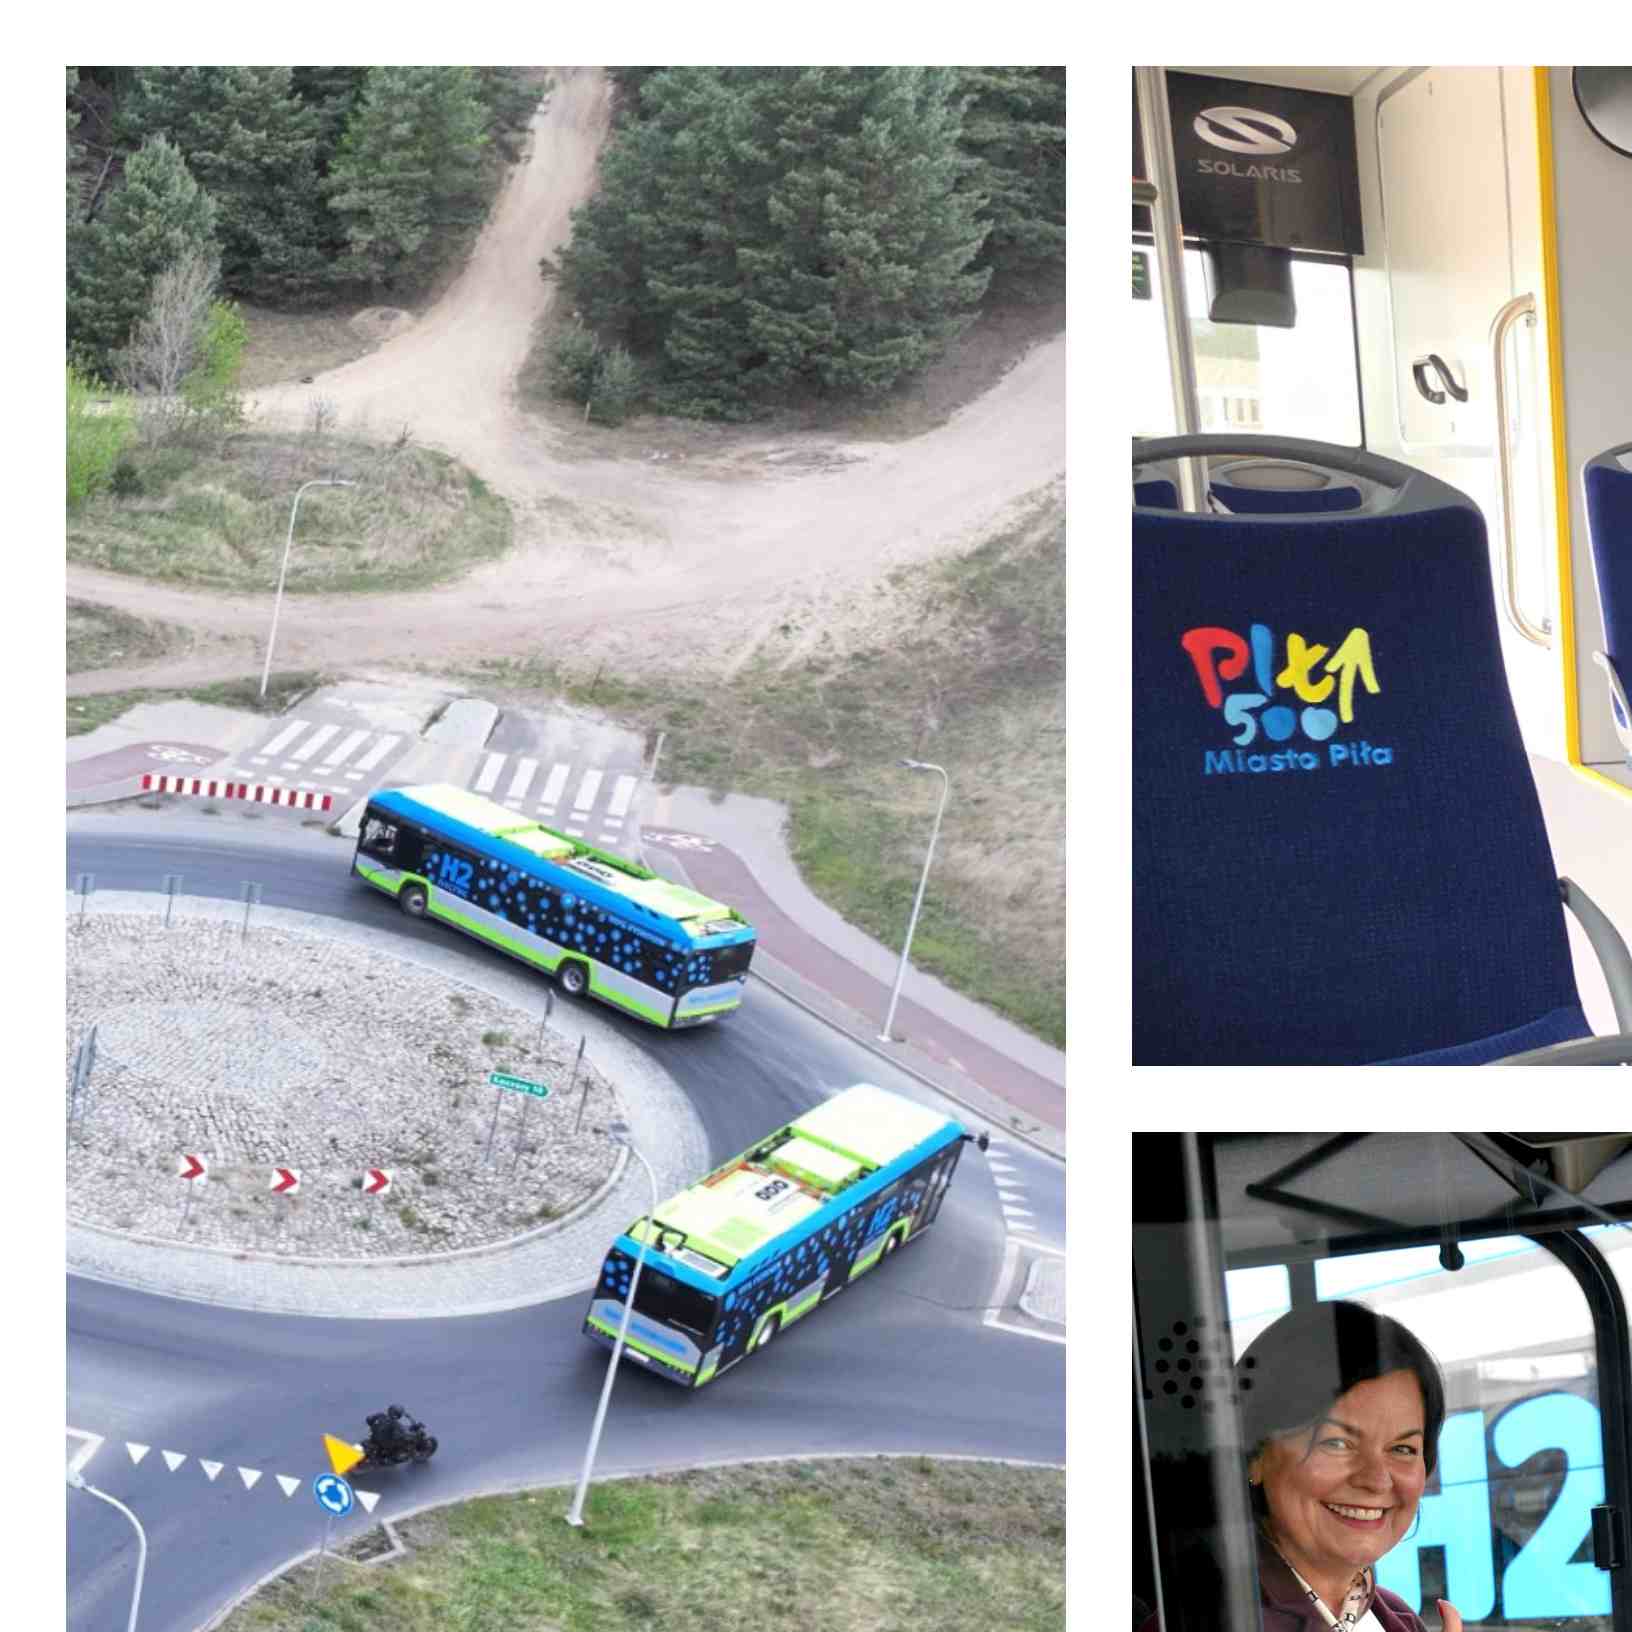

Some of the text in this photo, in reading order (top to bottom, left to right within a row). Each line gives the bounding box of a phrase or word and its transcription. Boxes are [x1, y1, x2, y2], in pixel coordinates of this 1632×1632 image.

[1196, 159, 1303, 184] SOLARIS
[1204, 740, 1392, 776] Miasto Piła
[441, 853, 473, 889] H2
